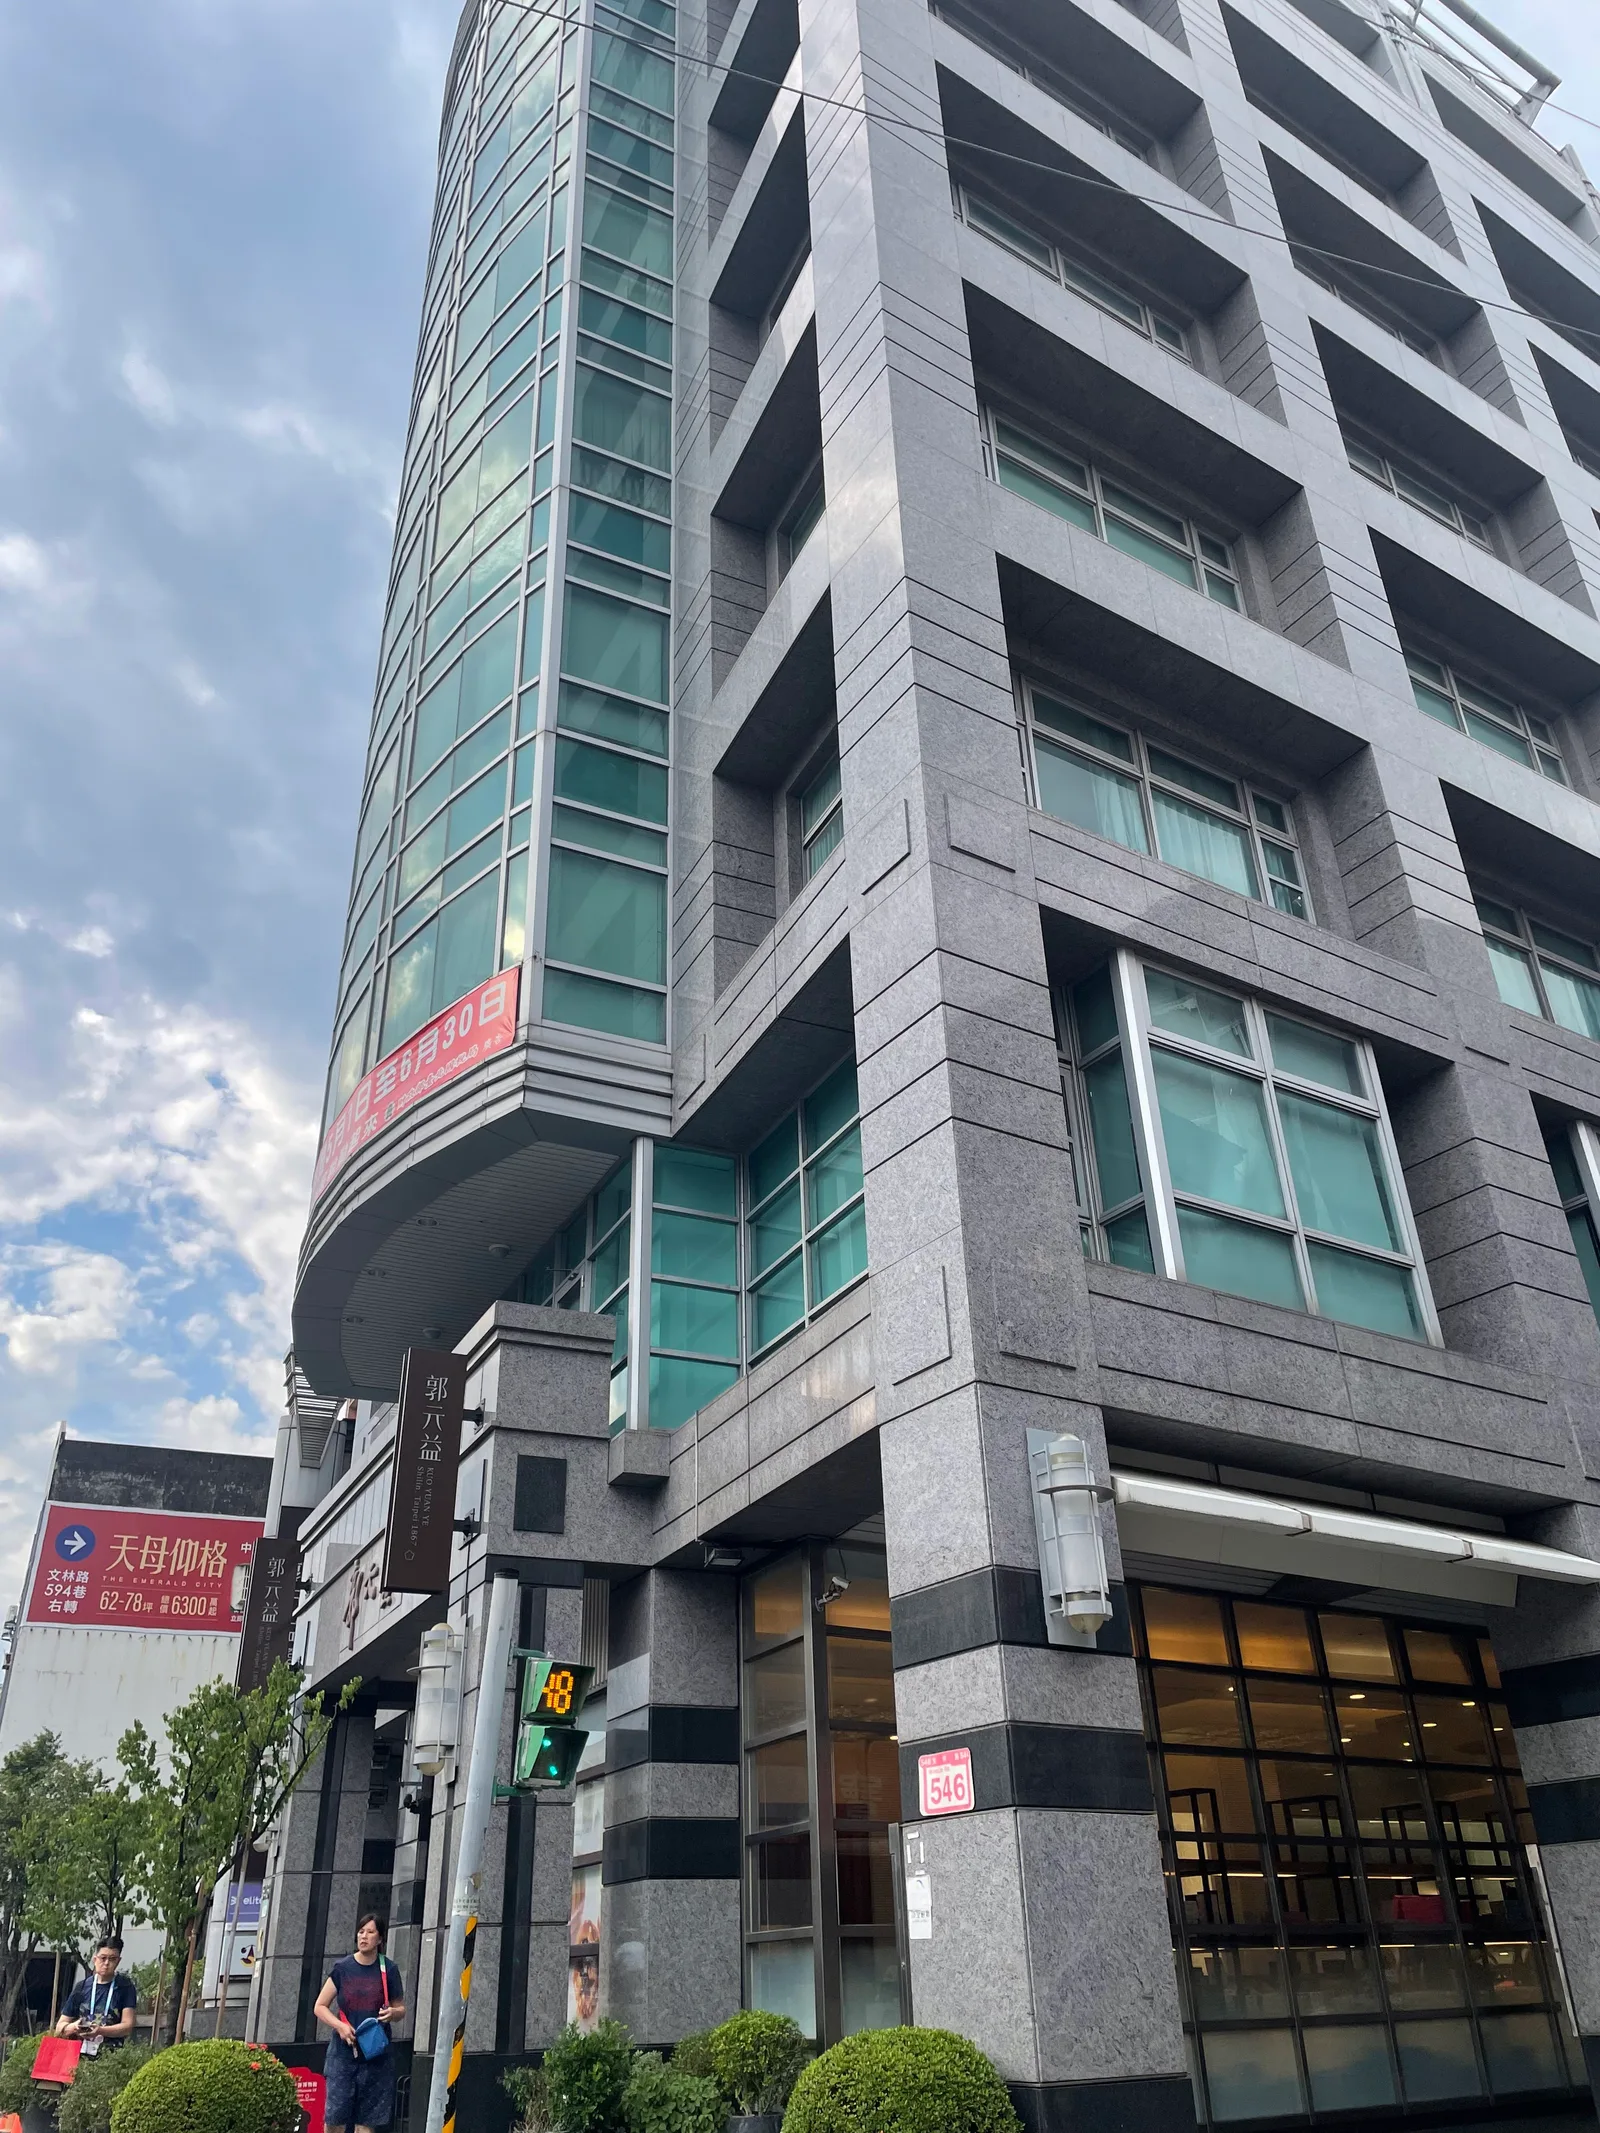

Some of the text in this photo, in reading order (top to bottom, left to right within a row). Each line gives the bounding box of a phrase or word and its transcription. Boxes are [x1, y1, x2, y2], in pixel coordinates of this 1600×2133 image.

[418, 1374, 449, 1463] 郭元益
[411, 1495, 422, 1522] Taipei
[421, 1467, 435, 1527] KUO YUAN YE
[410, 1525, 418, 1546] 1867
[105, 1534, 228, 1579] 天母仰格
[46, 1568, 90, 1584] 文林路
[102, 1575, 124, 1583] THE
[133, 1577, 187, 1587] EMERALD
[44, 1583, 87, 1599] 594巷
[100, 1590, 153, 1614] 62-78坪
[261, 1557, 286, 1623] 郭元益
[48, 1599, 79, 1614] 右轉
[931, 1773, 966, 1805] 546
